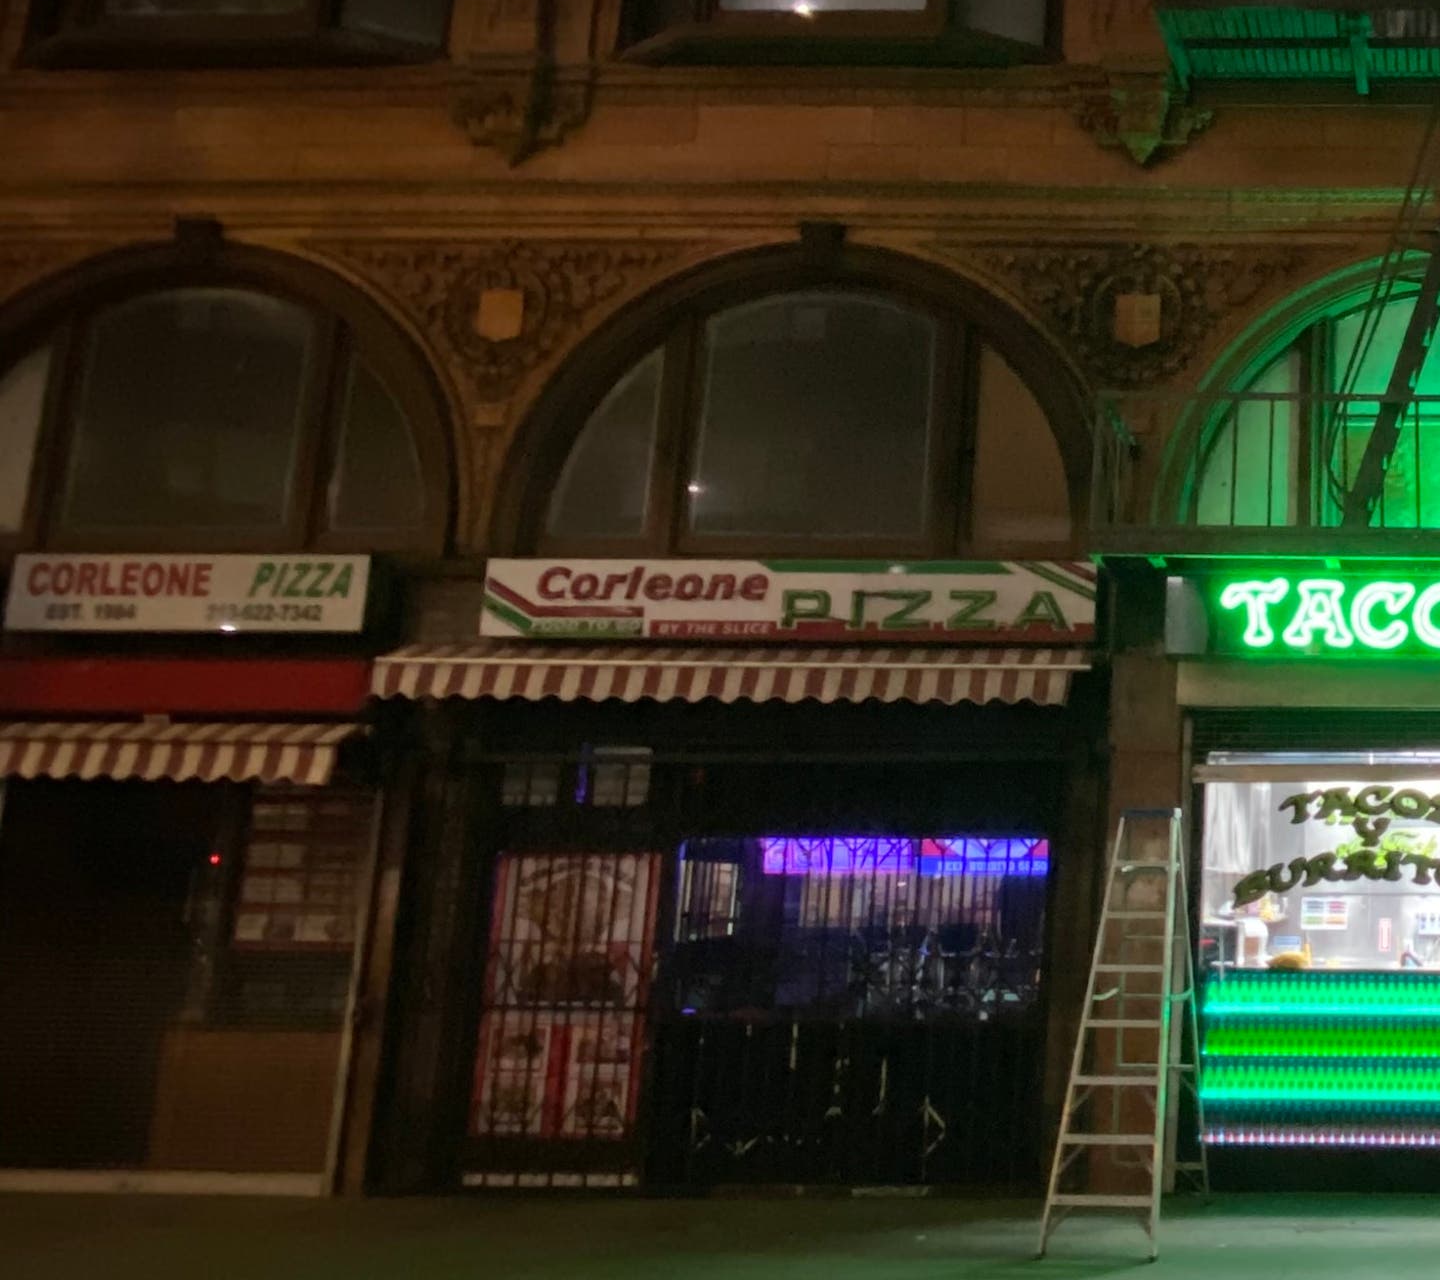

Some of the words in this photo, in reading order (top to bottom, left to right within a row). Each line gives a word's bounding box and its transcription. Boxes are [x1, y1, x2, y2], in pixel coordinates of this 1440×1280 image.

[26, 562, 212, 597] CORLEONE
[247, 563, 354, 598] PIZZA
[536, 566, 769, 601] Corleone
[780, 589, 1072, 631] PIZZA
[658, 621, 677, 634] BY
[687, 621, 715, 635] THE
[723, 621, 769, 635] SLICE
